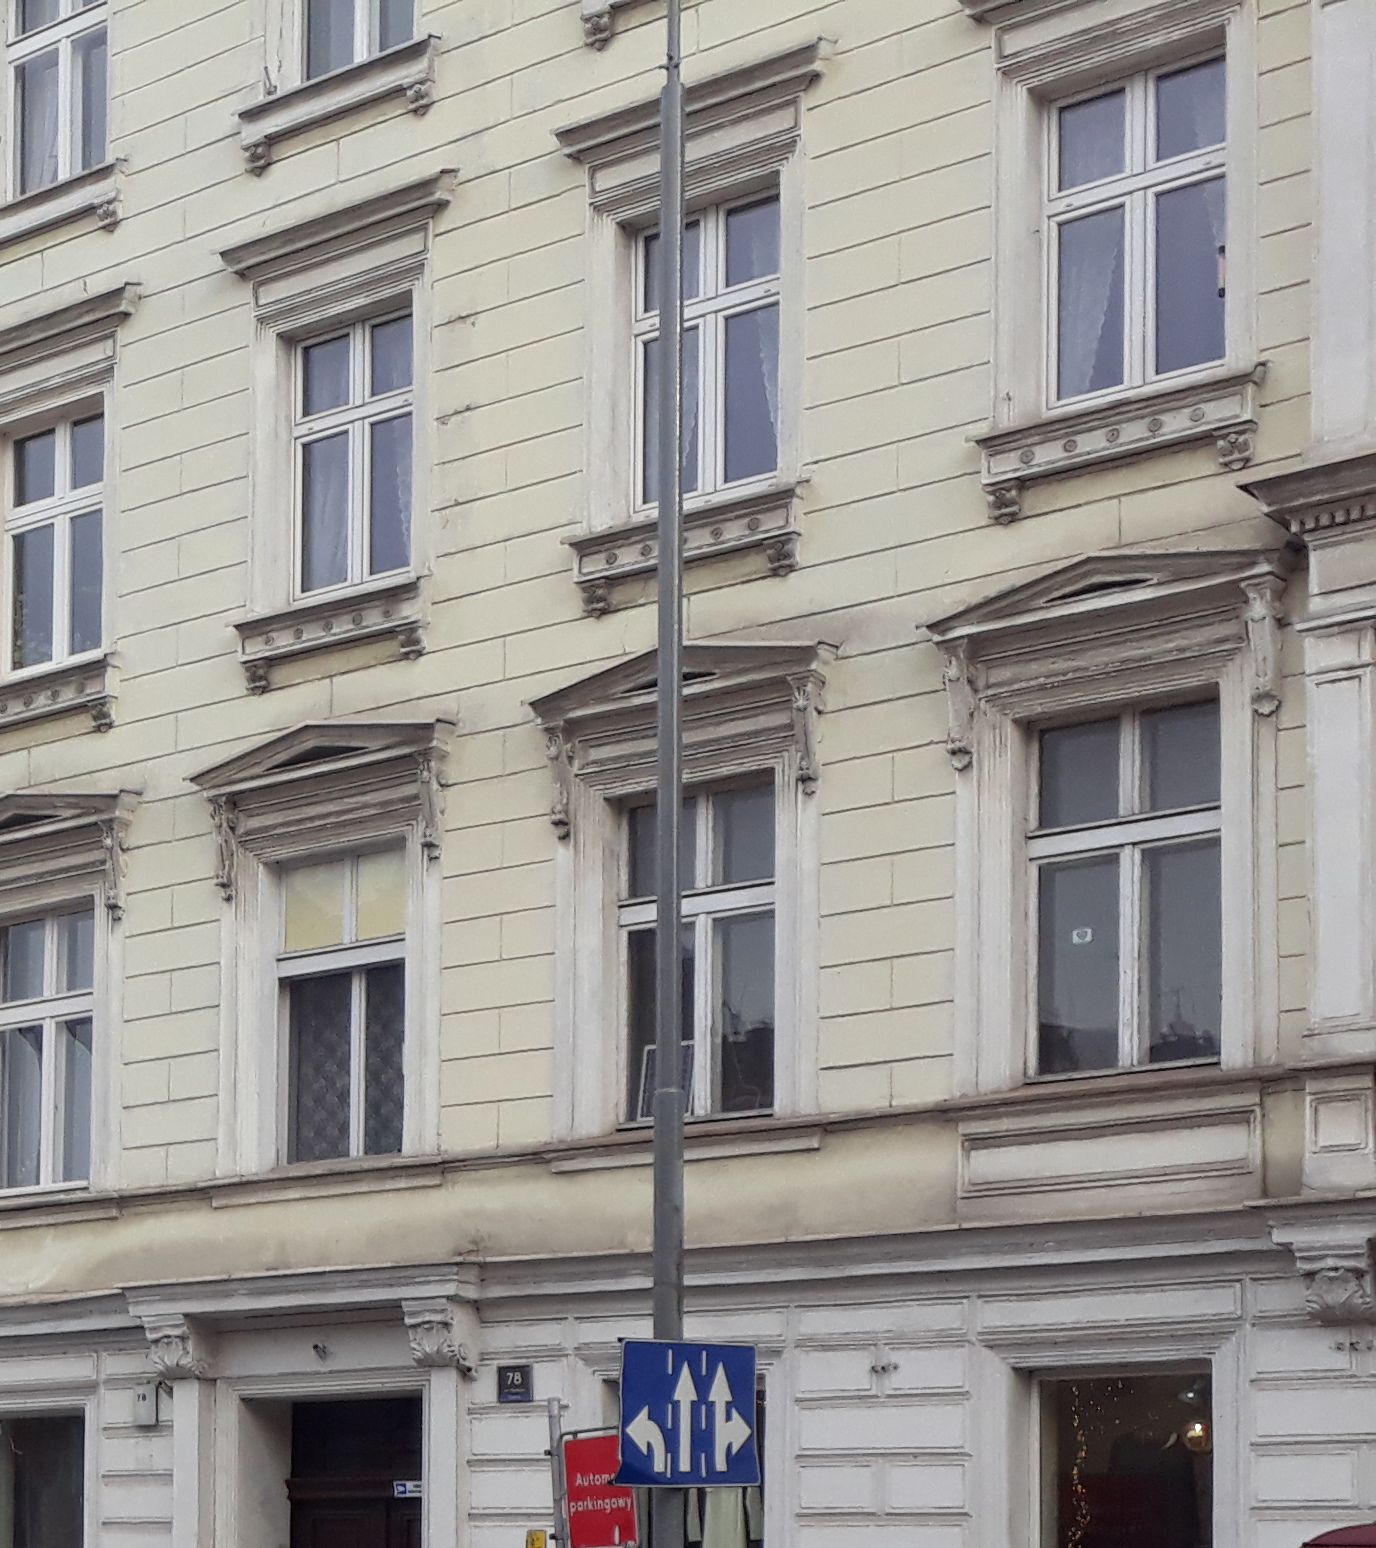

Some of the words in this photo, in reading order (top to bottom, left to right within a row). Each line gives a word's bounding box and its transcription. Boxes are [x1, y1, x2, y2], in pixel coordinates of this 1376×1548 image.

[505, 1371, 523, 1386] 78
[575, 1472, 616, 1487] Autom
[569, 1496, 632, 1517] parkingowy
